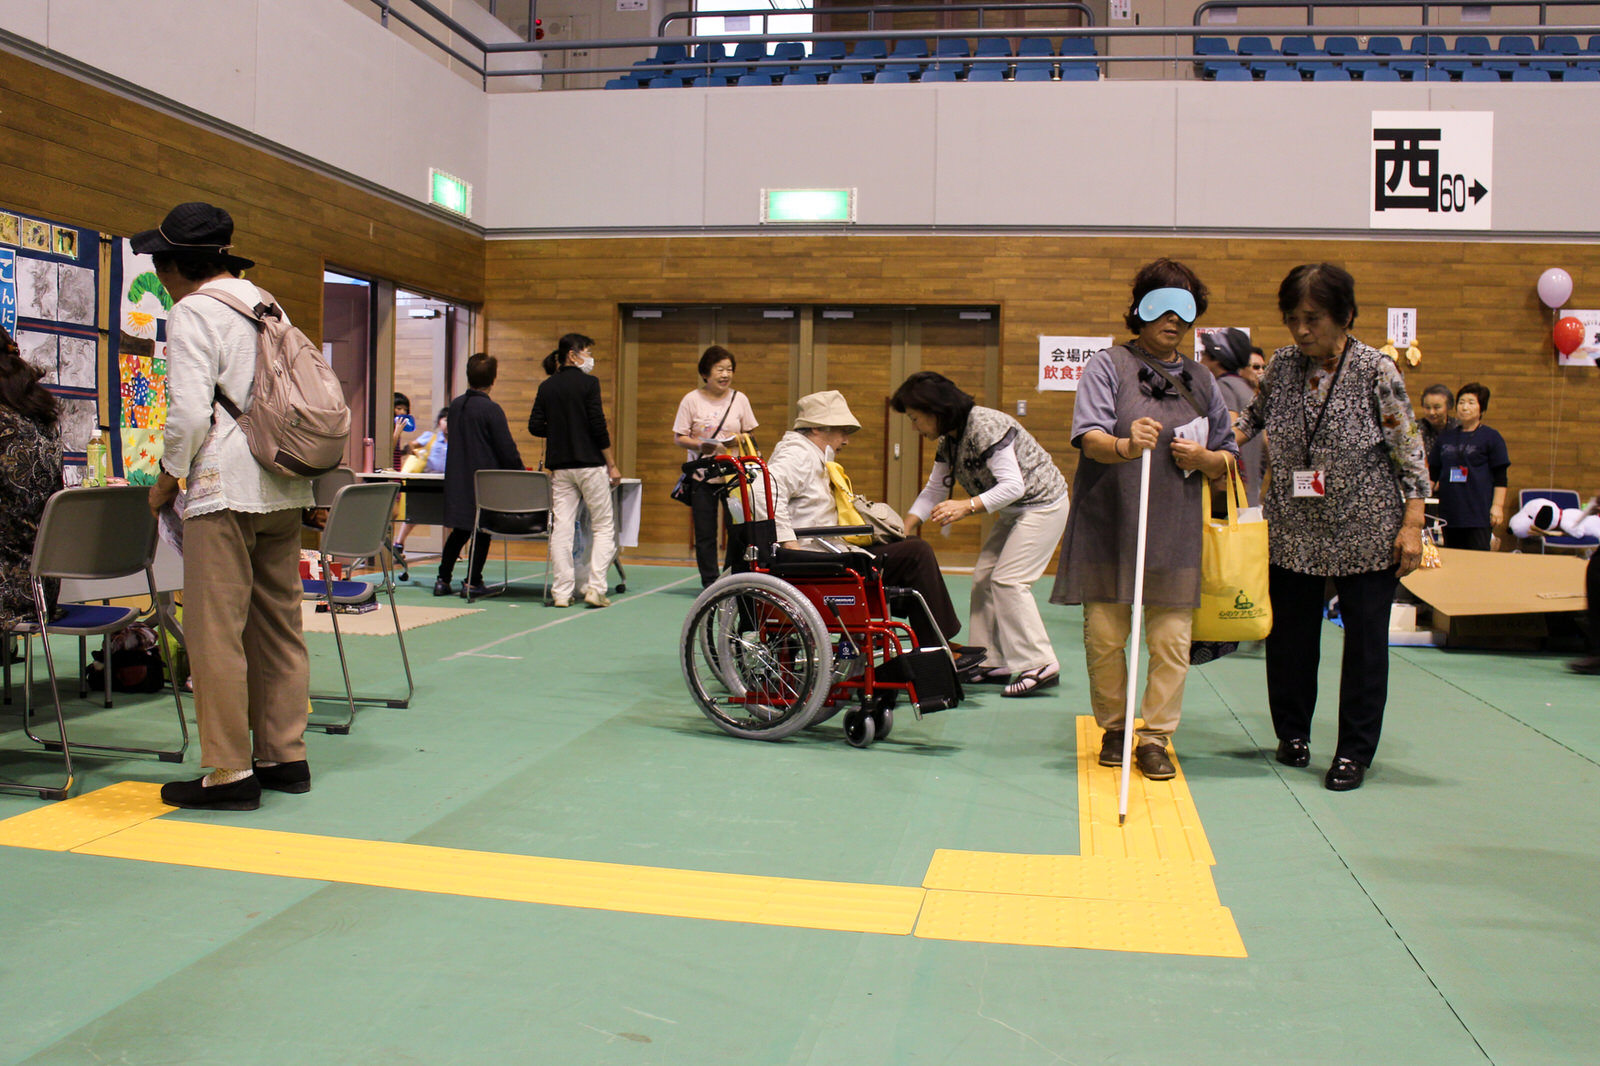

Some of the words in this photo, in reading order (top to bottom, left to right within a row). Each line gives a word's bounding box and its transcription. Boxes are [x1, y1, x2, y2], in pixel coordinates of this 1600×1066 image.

[1373, 128, 1441, 212] 西
[1440, 174, 1466, 212] 60
[0, 258, 14, 333] こんに
